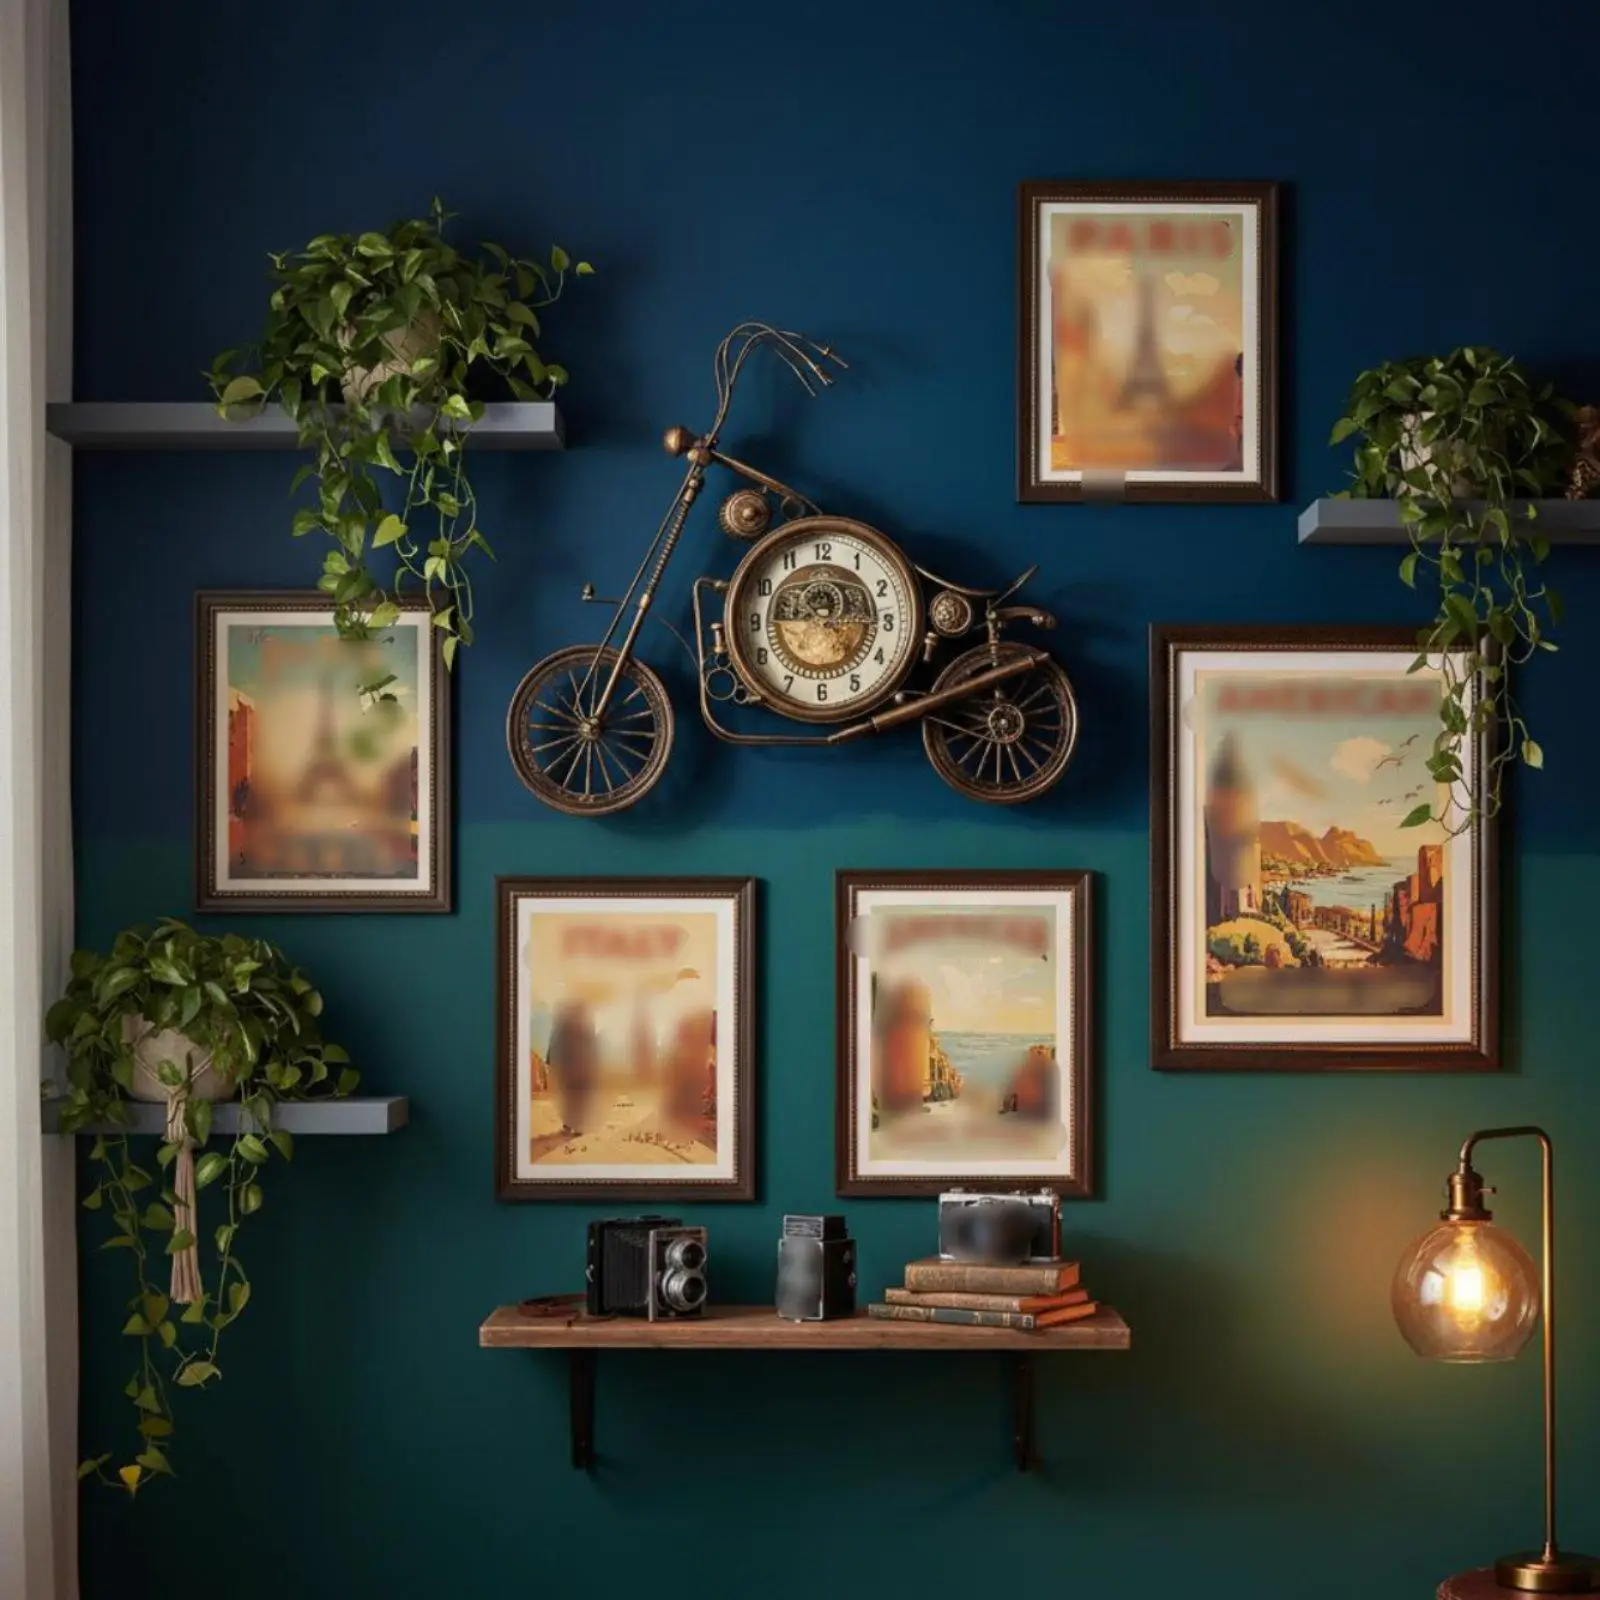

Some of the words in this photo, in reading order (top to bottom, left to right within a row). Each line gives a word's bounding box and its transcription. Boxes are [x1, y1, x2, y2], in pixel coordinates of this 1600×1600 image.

[783, 551, 796, 570] 11
[815, 543, 832, 561] 12
[854, 553, 861, 570] 1
[758, 579, 772, 596] 10
[876, 580, 888, 597] 2
[883, 614, 894, 632] 3
[757, 648, 768, 665] 8
[874, 648, 884, 665] 4
[784, 676, 794, 693] 7
[850, 674, 861, 692] 5
[817, 683, 827, 701] 6
